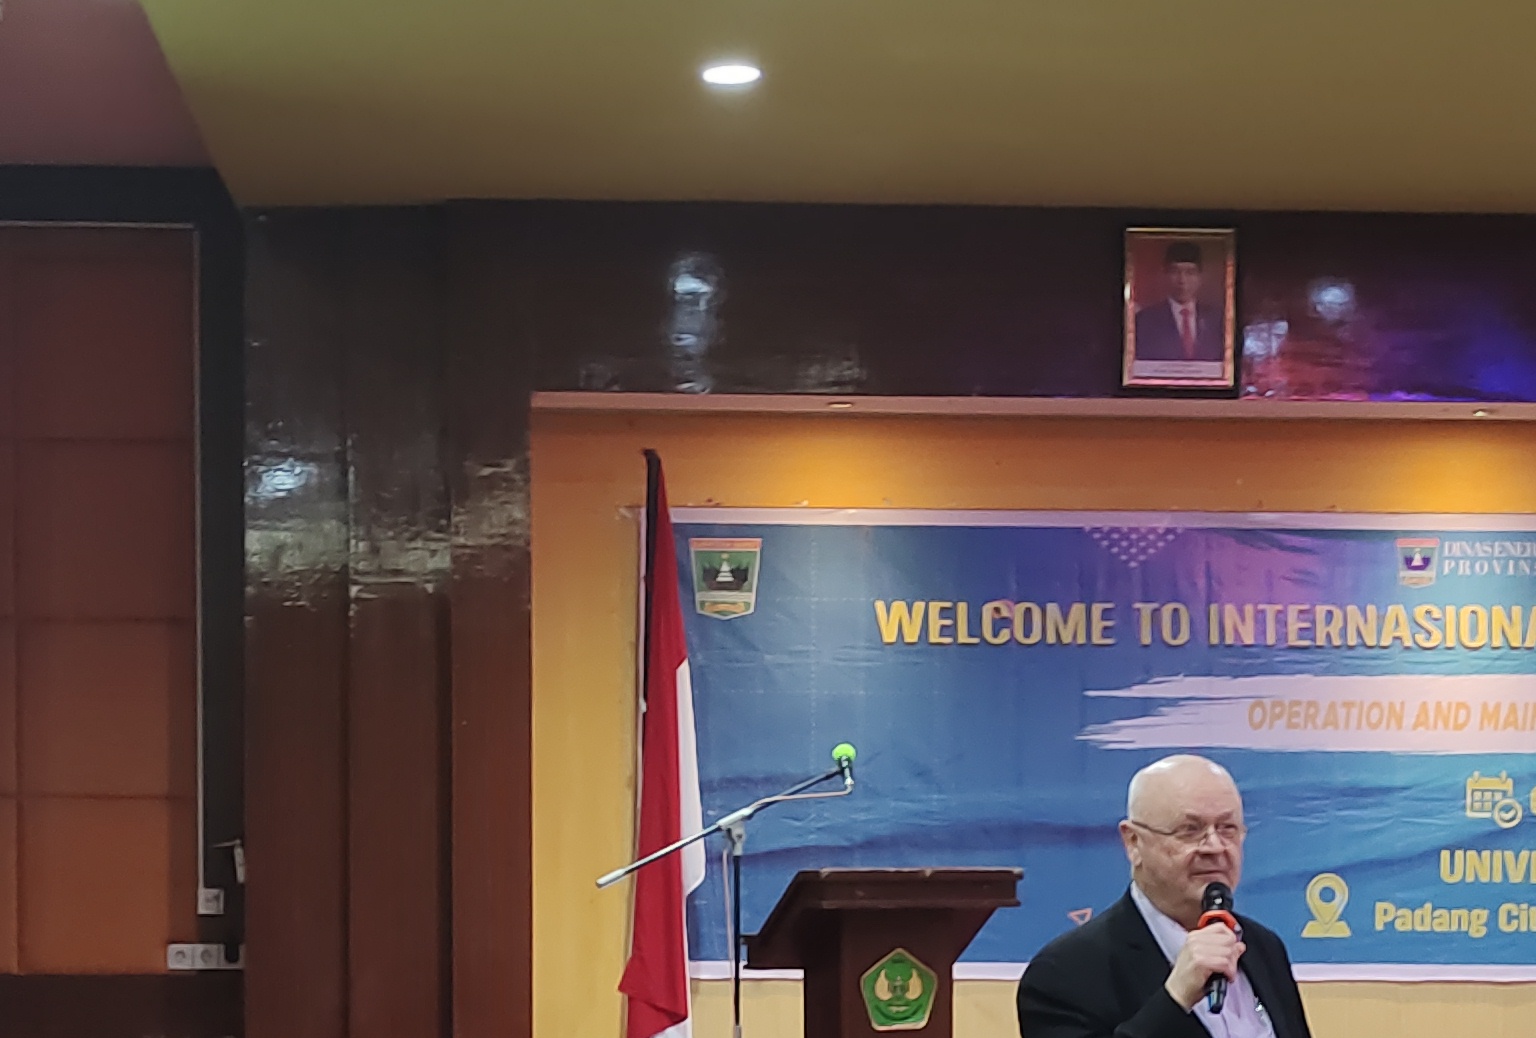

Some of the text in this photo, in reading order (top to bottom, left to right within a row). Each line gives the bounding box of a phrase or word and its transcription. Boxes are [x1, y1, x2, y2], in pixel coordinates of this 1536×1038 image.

[874, 600, 1117, 645] WELCOME
[1133, 602, 1191, 646] TO
[1248, 700, 1405, 731] OPERATION
[1412, 701, 1471, 731] AND
[1375, 901, 1489, 938] Padang
